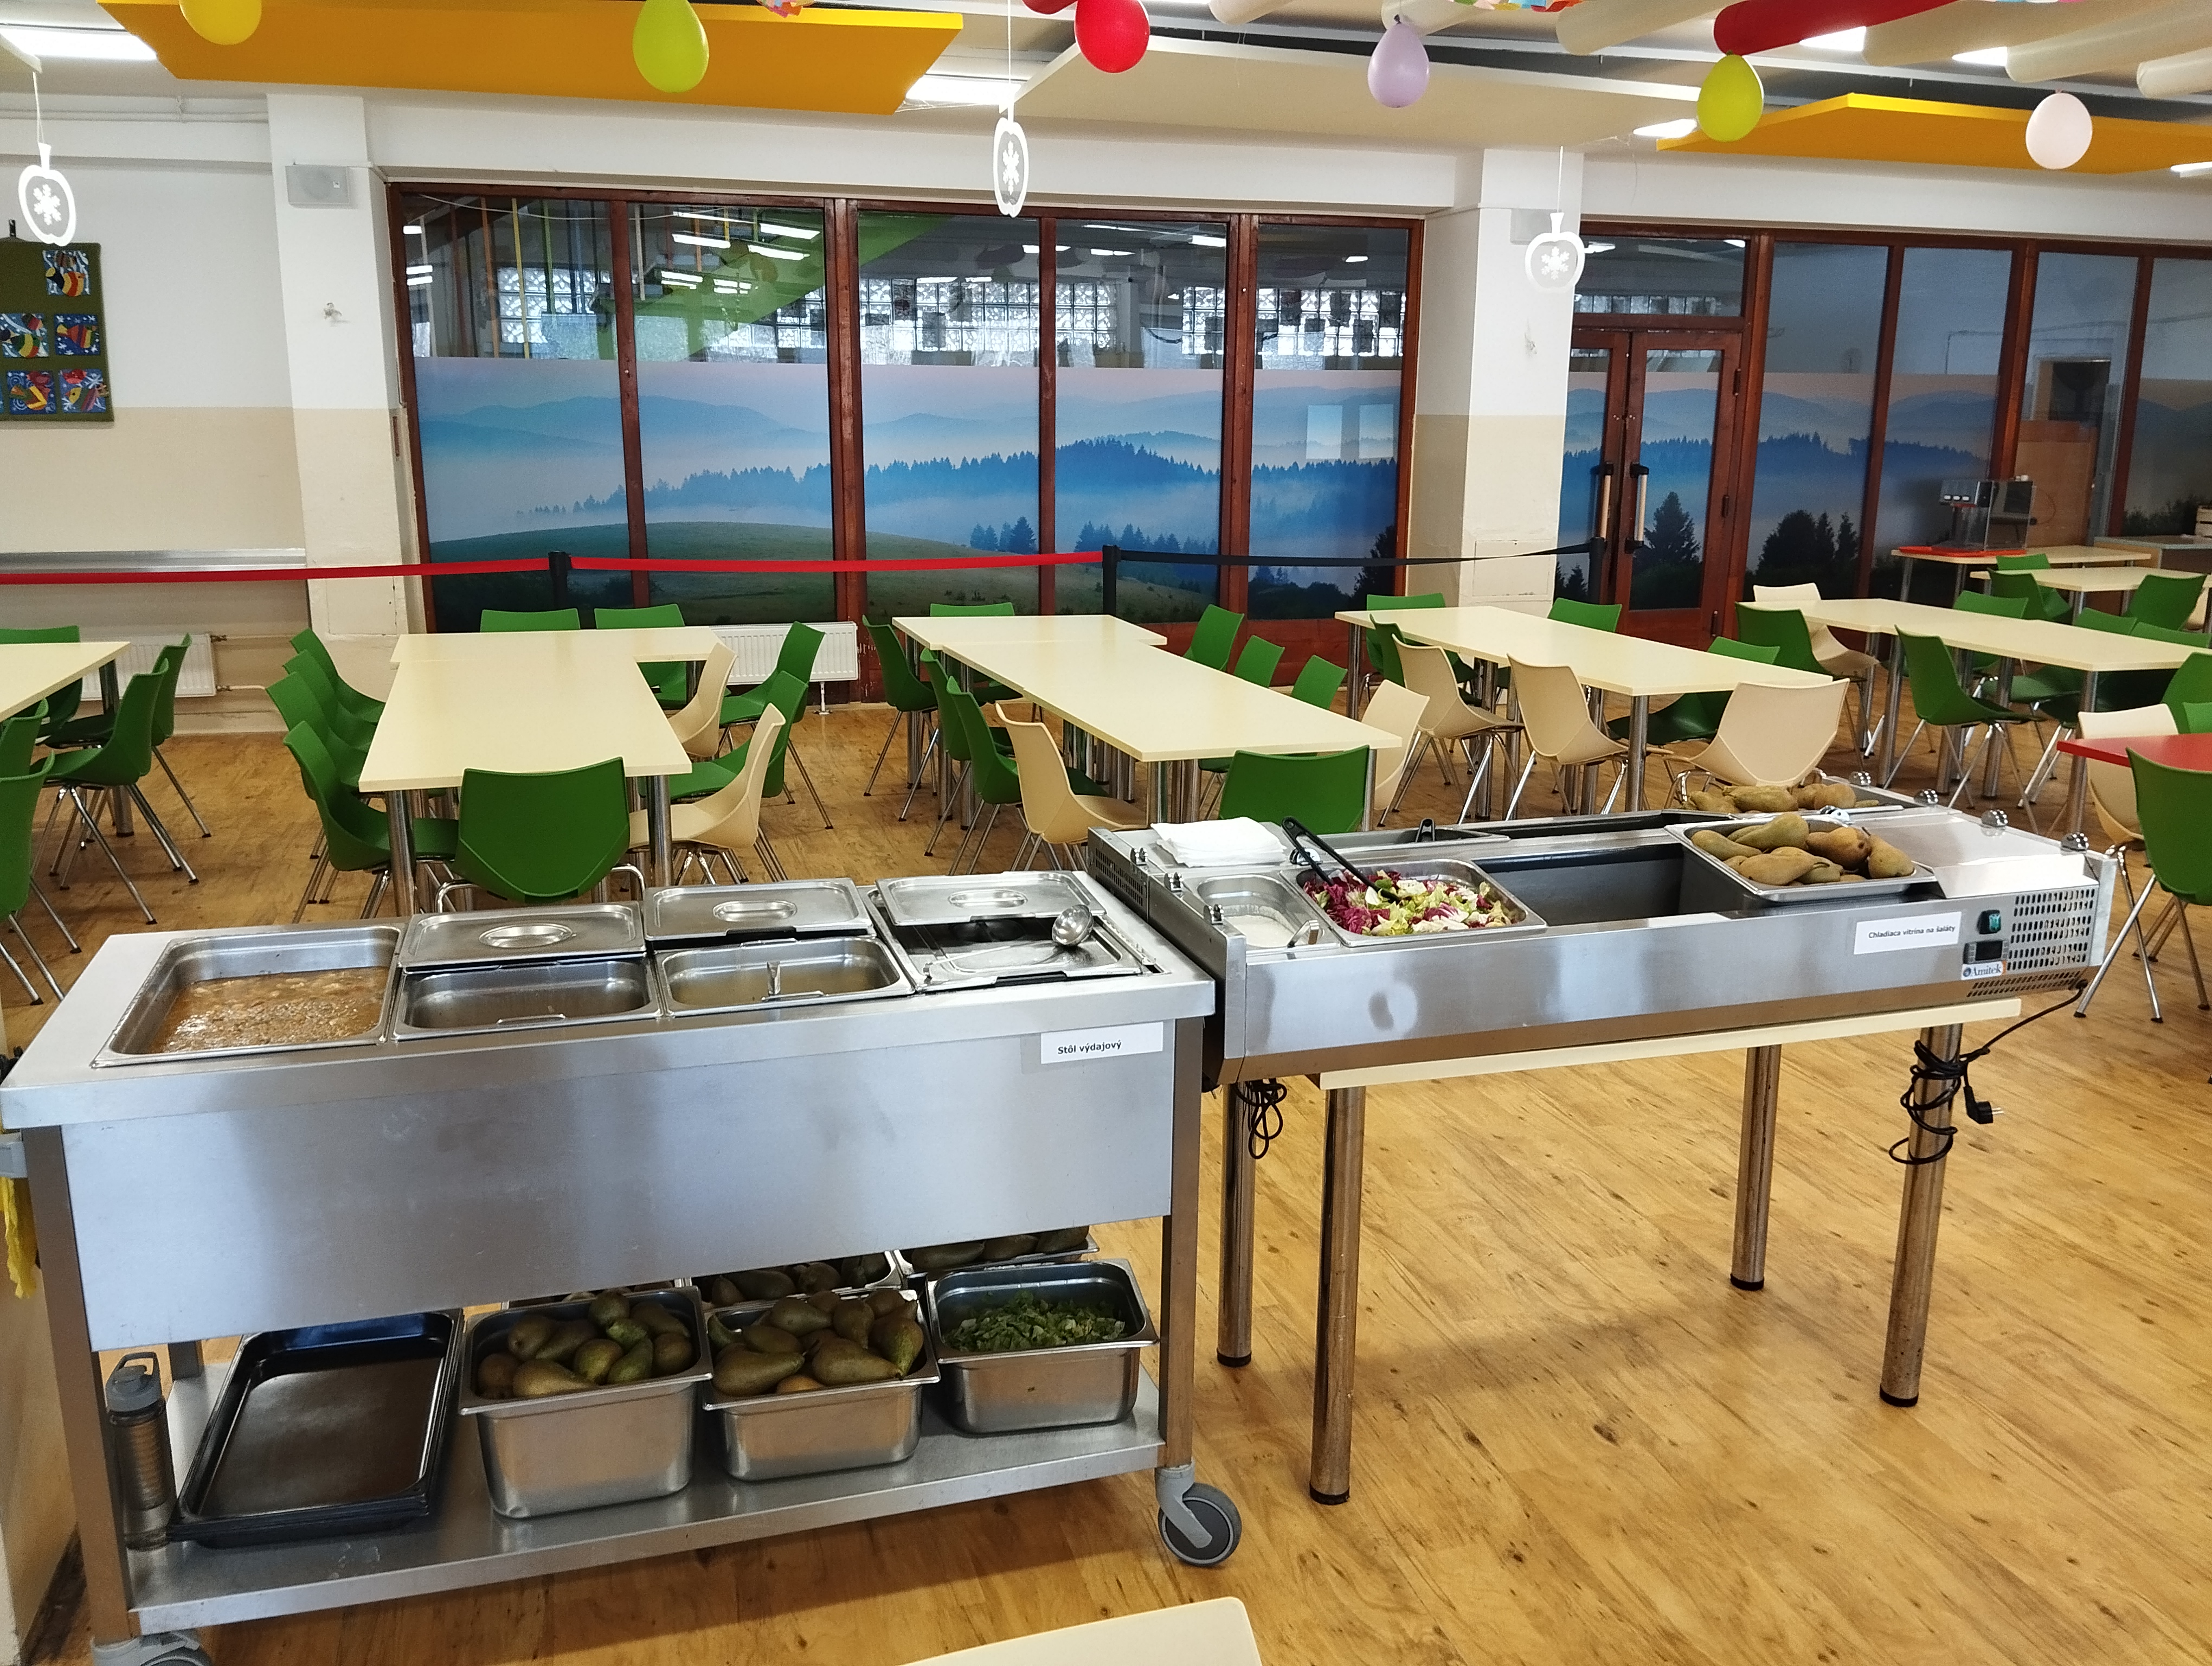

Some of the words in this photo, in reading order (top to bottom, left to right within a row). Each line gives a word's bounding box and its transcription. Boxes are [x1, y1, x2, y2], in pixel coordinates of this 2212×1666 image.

[1868, 930, 1901, 939] Chladiaca
[1971, 964, 2001, 976] Amitek
[1057, 1045, 1076, 1055] Stôl
[1079, 1040, 1122, 1053] výdajový
